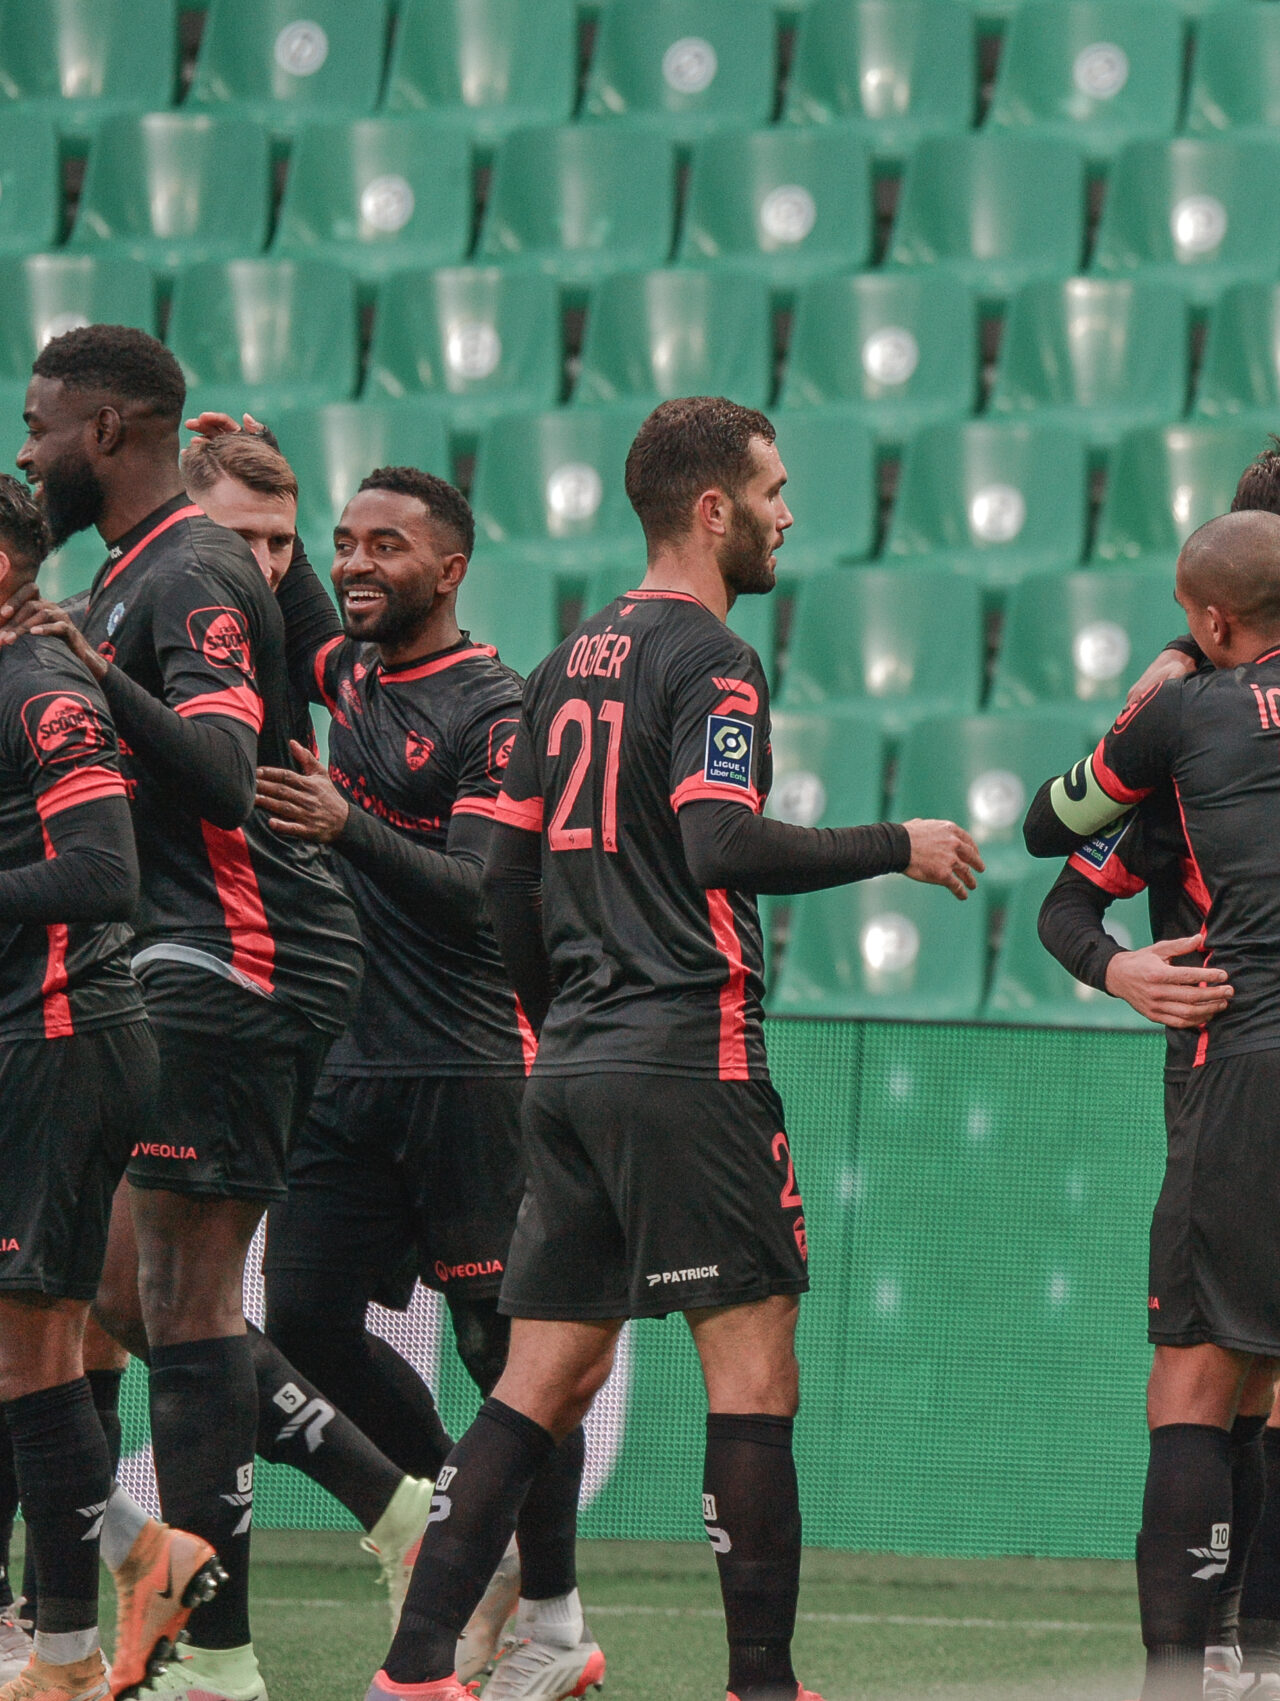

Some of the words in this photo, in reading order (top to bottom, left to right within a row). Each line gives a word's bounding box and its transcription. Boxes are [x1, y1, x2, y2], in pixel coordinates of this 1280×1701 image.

[713, 760, 740, 771] LIGUE
[546, 698, 624, 853] 21
[710, 768, 729, 777] Uber
[729, 771, 747, 783] Eats
[140, 1142, 197, 1160] VEOLIA
[447, 1259, 504, 1278] VEOLIA
[662, 1265, 719, 1284] PATRICK
[1215, 1528, 1228, 1545] 10
